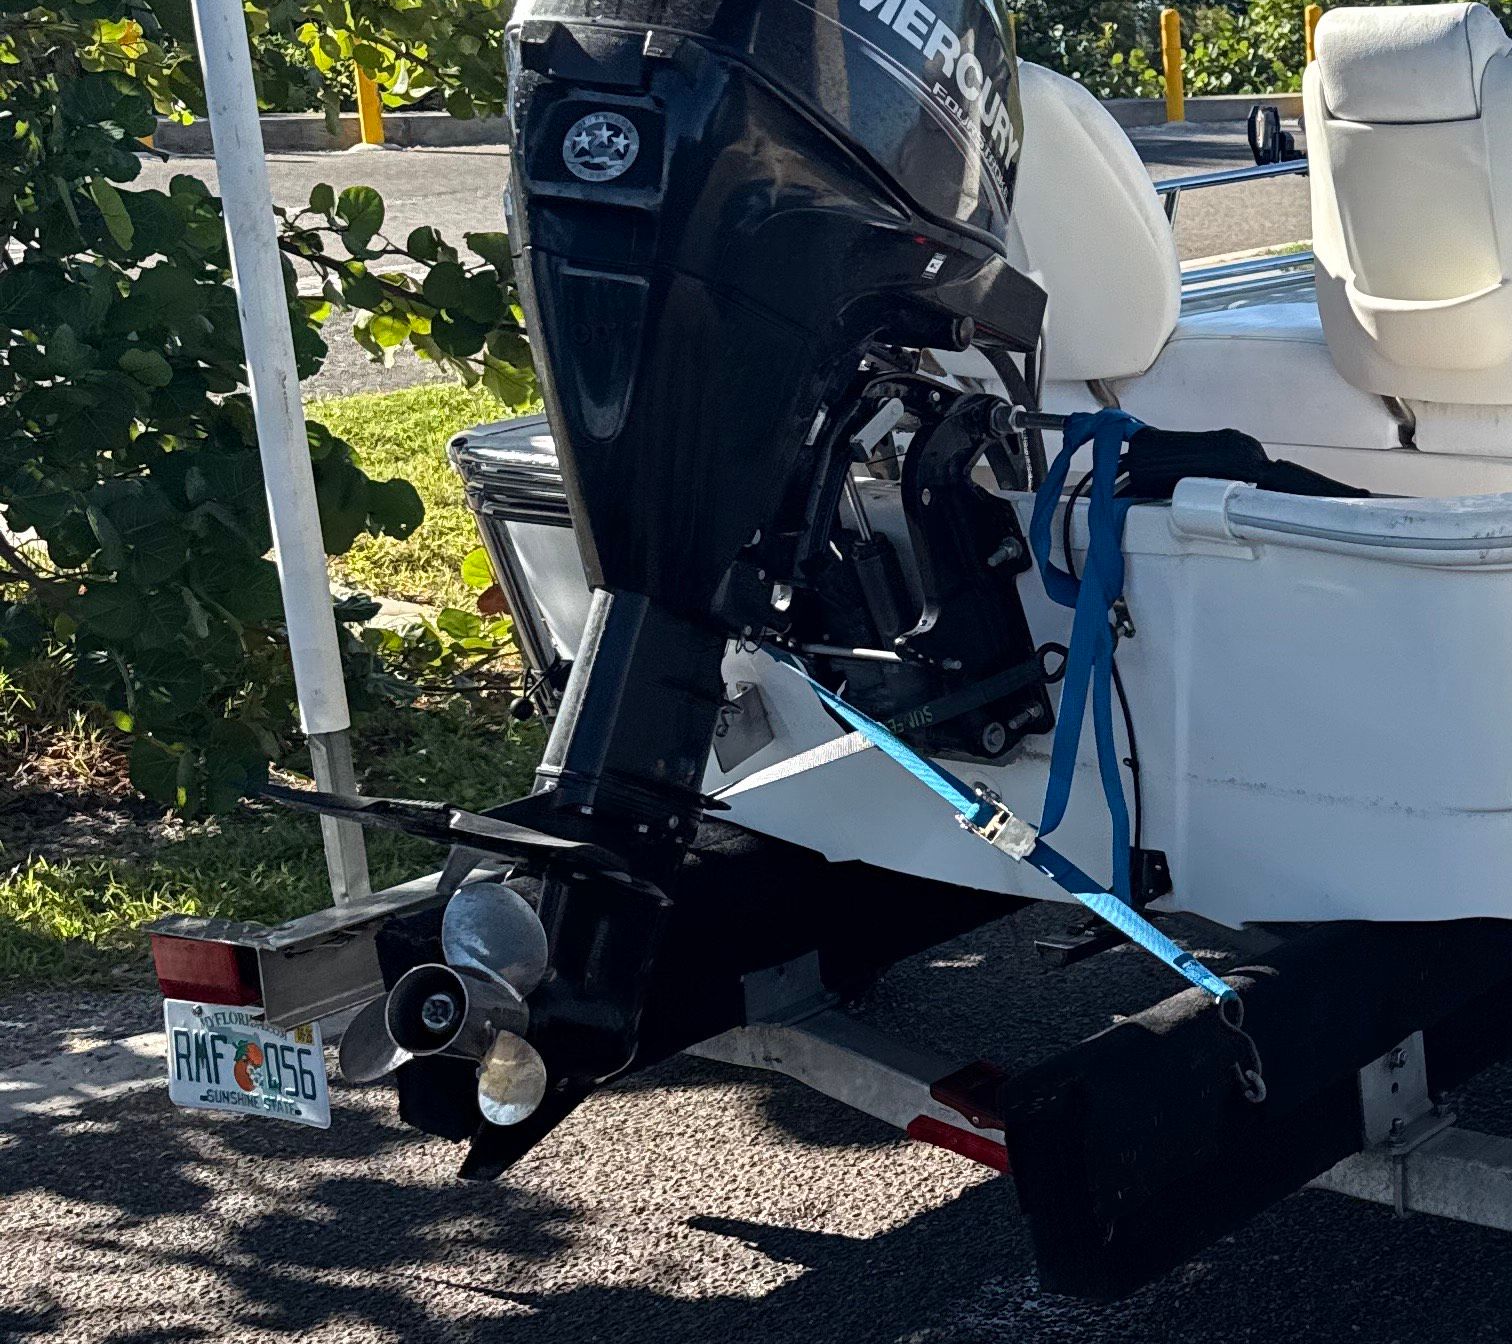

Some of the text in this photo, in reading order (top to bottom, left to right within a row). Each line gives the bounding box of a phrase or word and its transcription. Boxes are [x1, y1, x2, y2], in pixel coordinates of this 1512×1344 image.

[173, 1029, 228, 1085] RMF
[206, 1088, 297, 1116] SUNSHINE STATE
